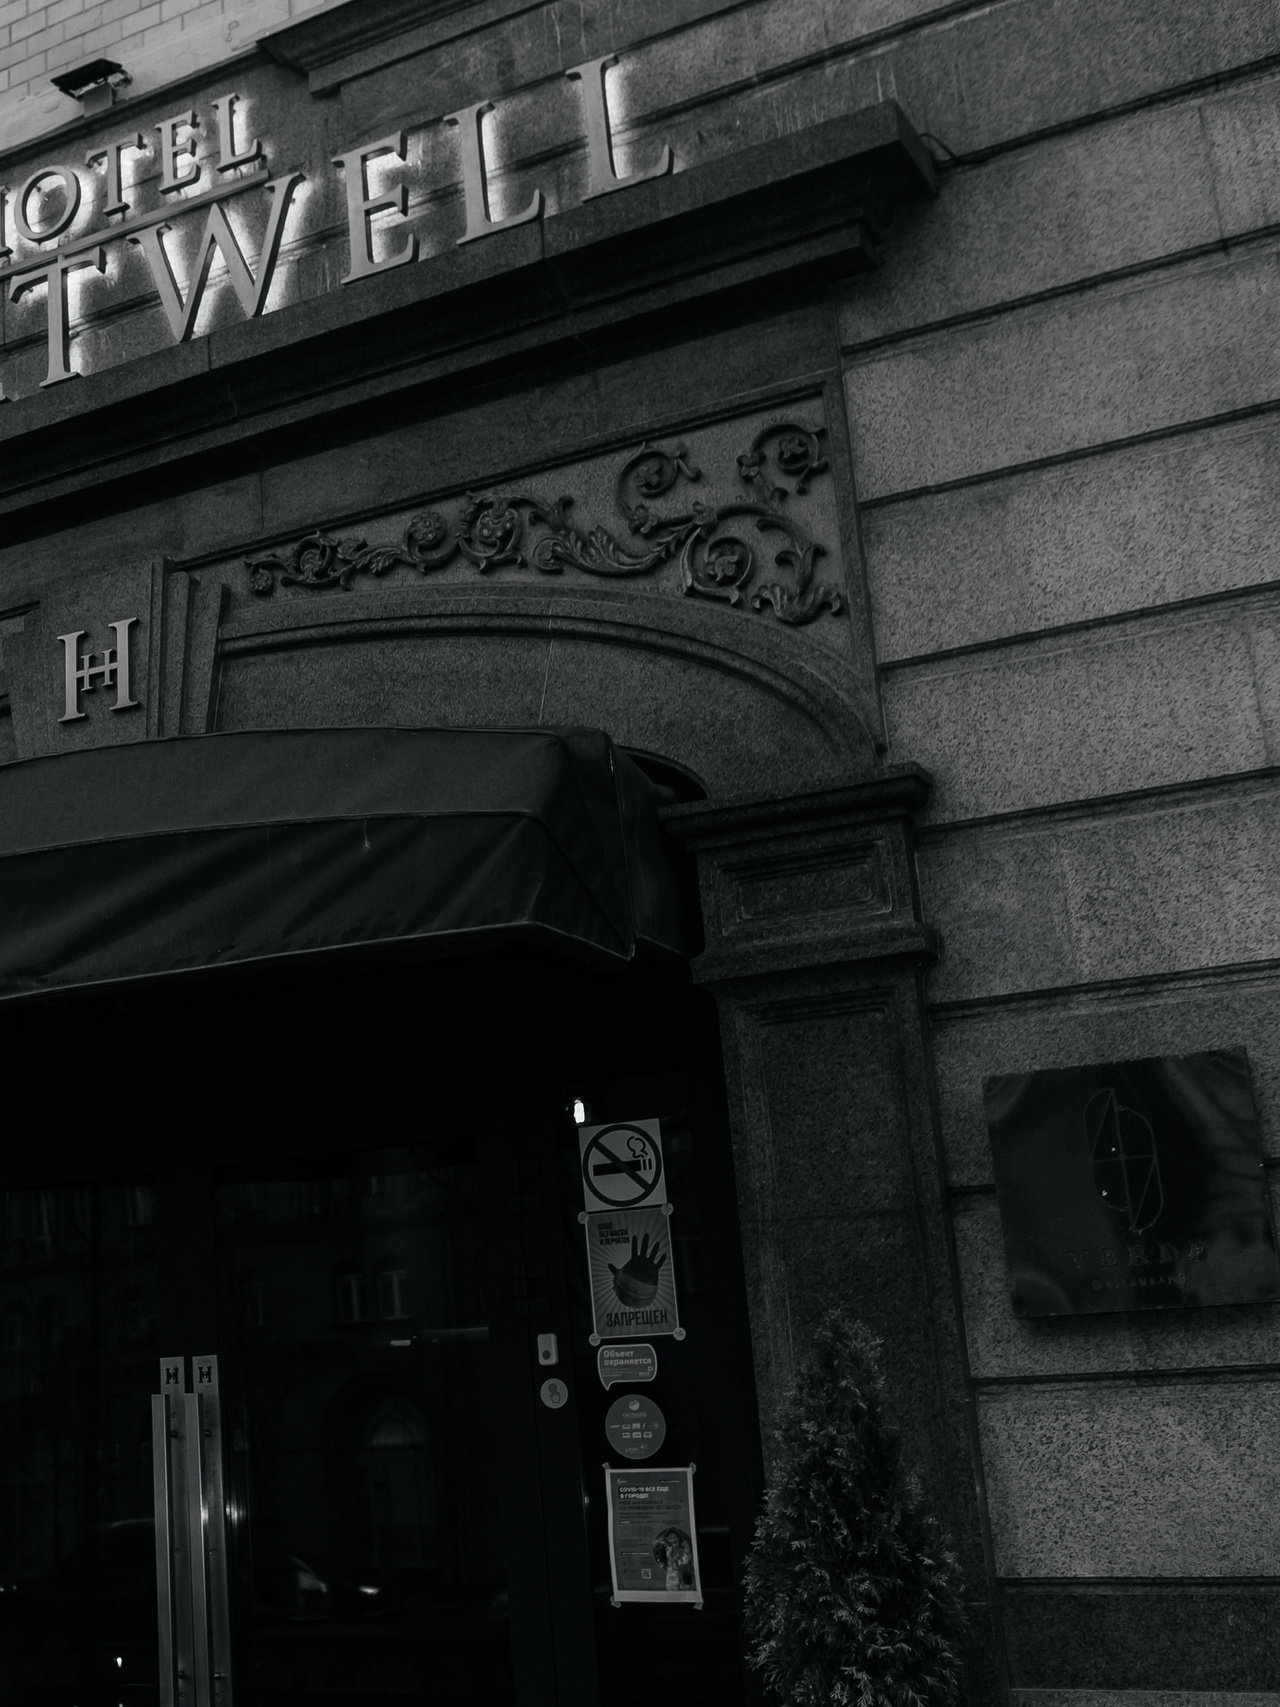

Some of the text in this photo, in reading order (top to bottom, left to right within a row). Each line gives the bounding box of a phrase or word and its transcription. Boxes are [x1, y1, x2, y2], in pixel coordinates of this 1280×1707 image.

[606, 1309, 668, 1327] ЗАПРЕЩЕН
[603, 1350, 634, 1358] Объект
[604, 1358, 652, 1367] охраняется
